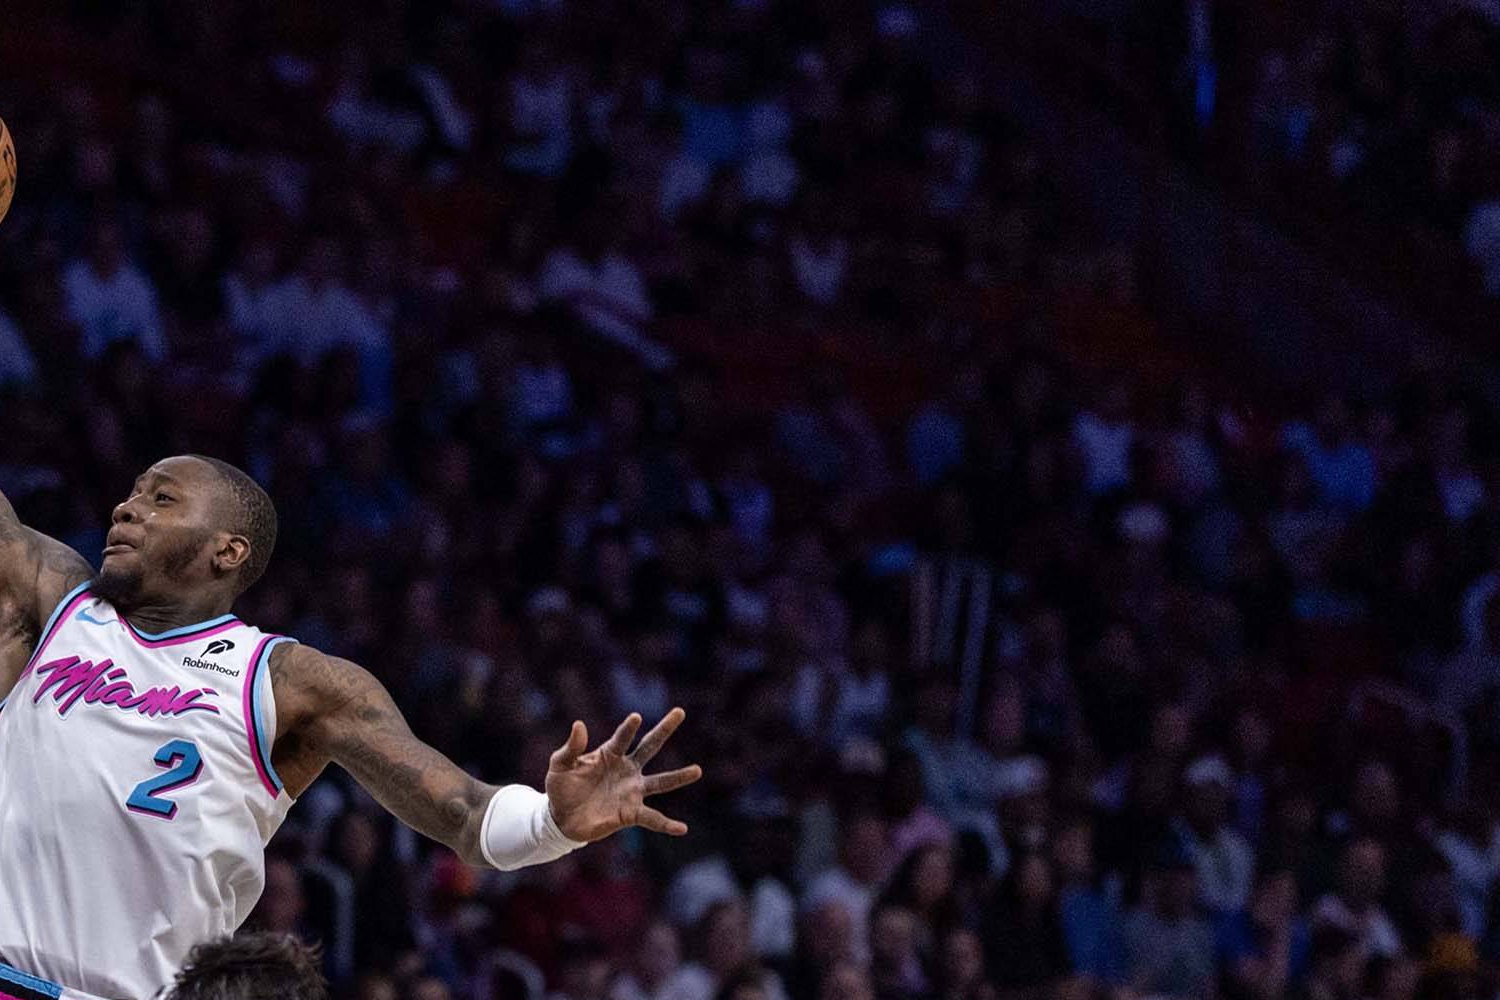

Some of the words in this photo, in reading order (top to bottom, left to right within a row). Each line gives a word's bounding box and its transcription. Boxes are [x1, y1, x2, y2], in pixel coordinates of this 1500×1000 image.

[34, 655, 221, 716] Miami
[182, 656, 240, 678] Robinhood
[125, 739, 204, 820] 2
